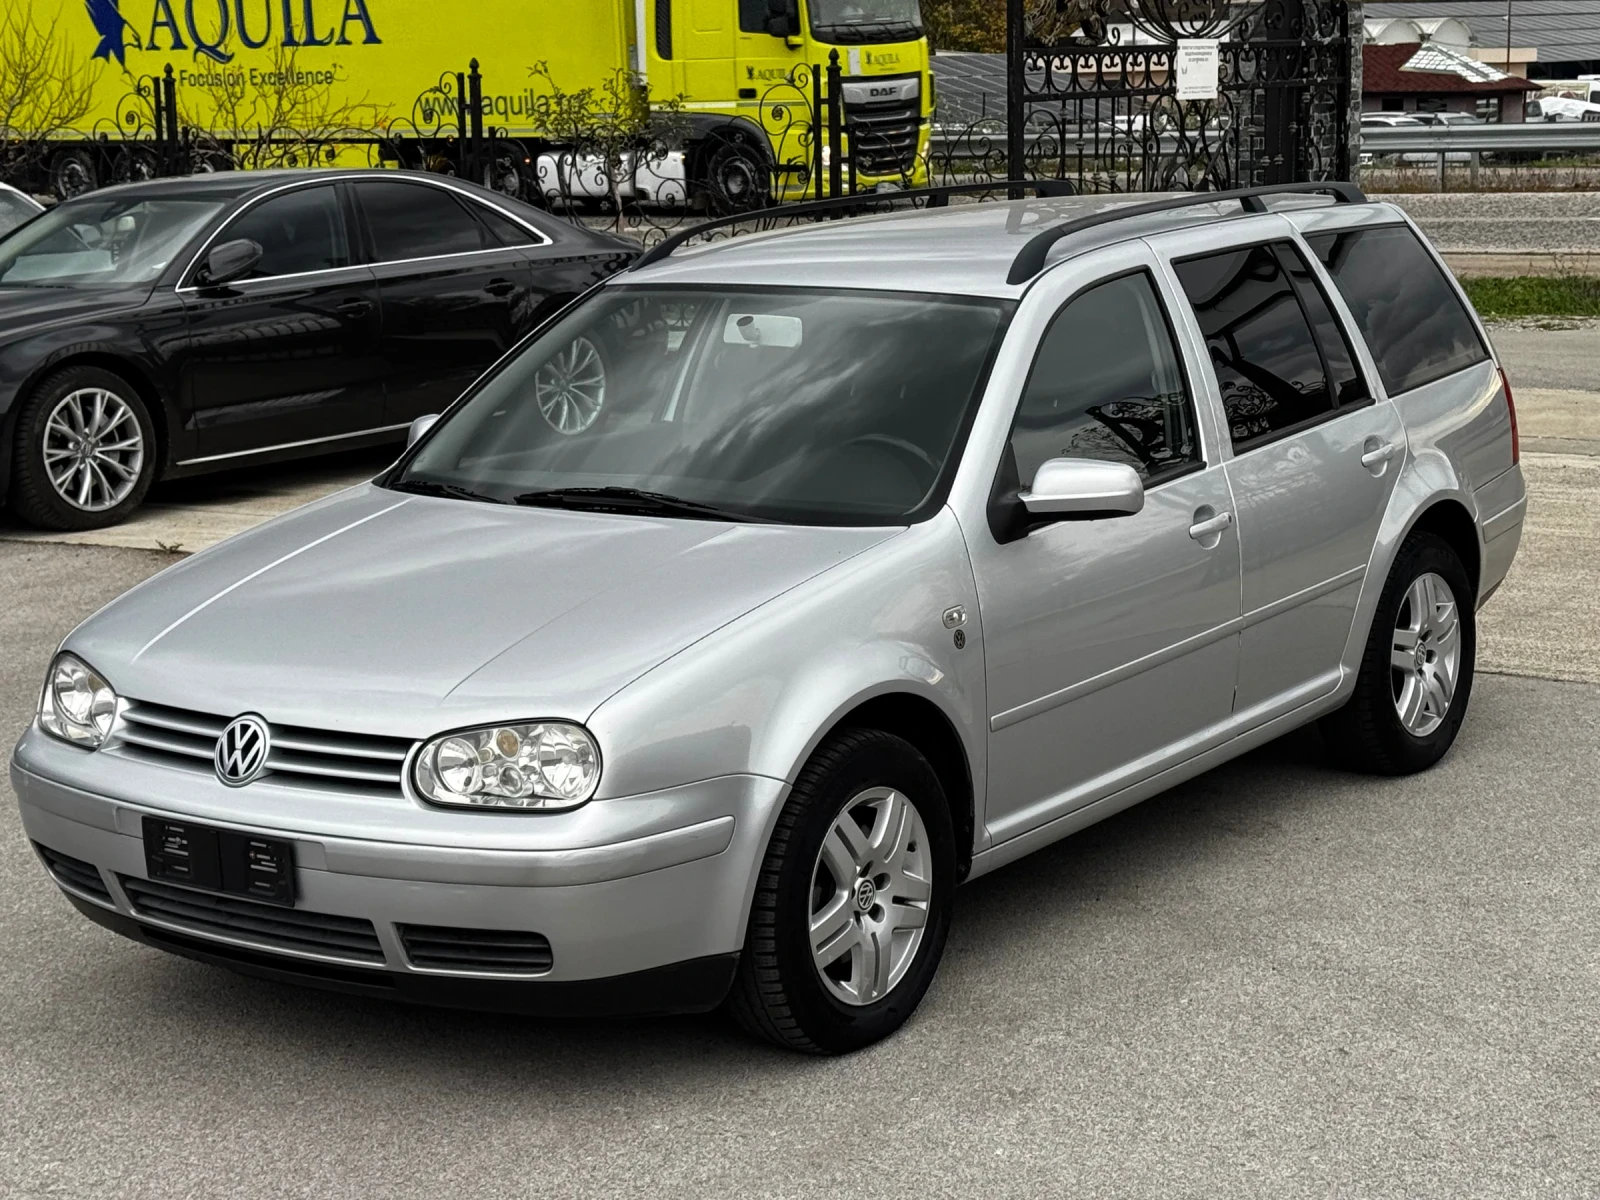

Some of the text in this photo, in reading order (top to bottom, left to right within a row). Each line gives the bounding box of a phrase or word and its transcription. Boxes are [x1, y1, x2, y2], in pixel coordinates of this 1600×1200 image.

[145, 0, 383, 64] AQUILA
[179, 68, 334, 87] Focus on Excellence
[869, 87, 898, 97] DAF
[217, 717, 267, 783] VW
